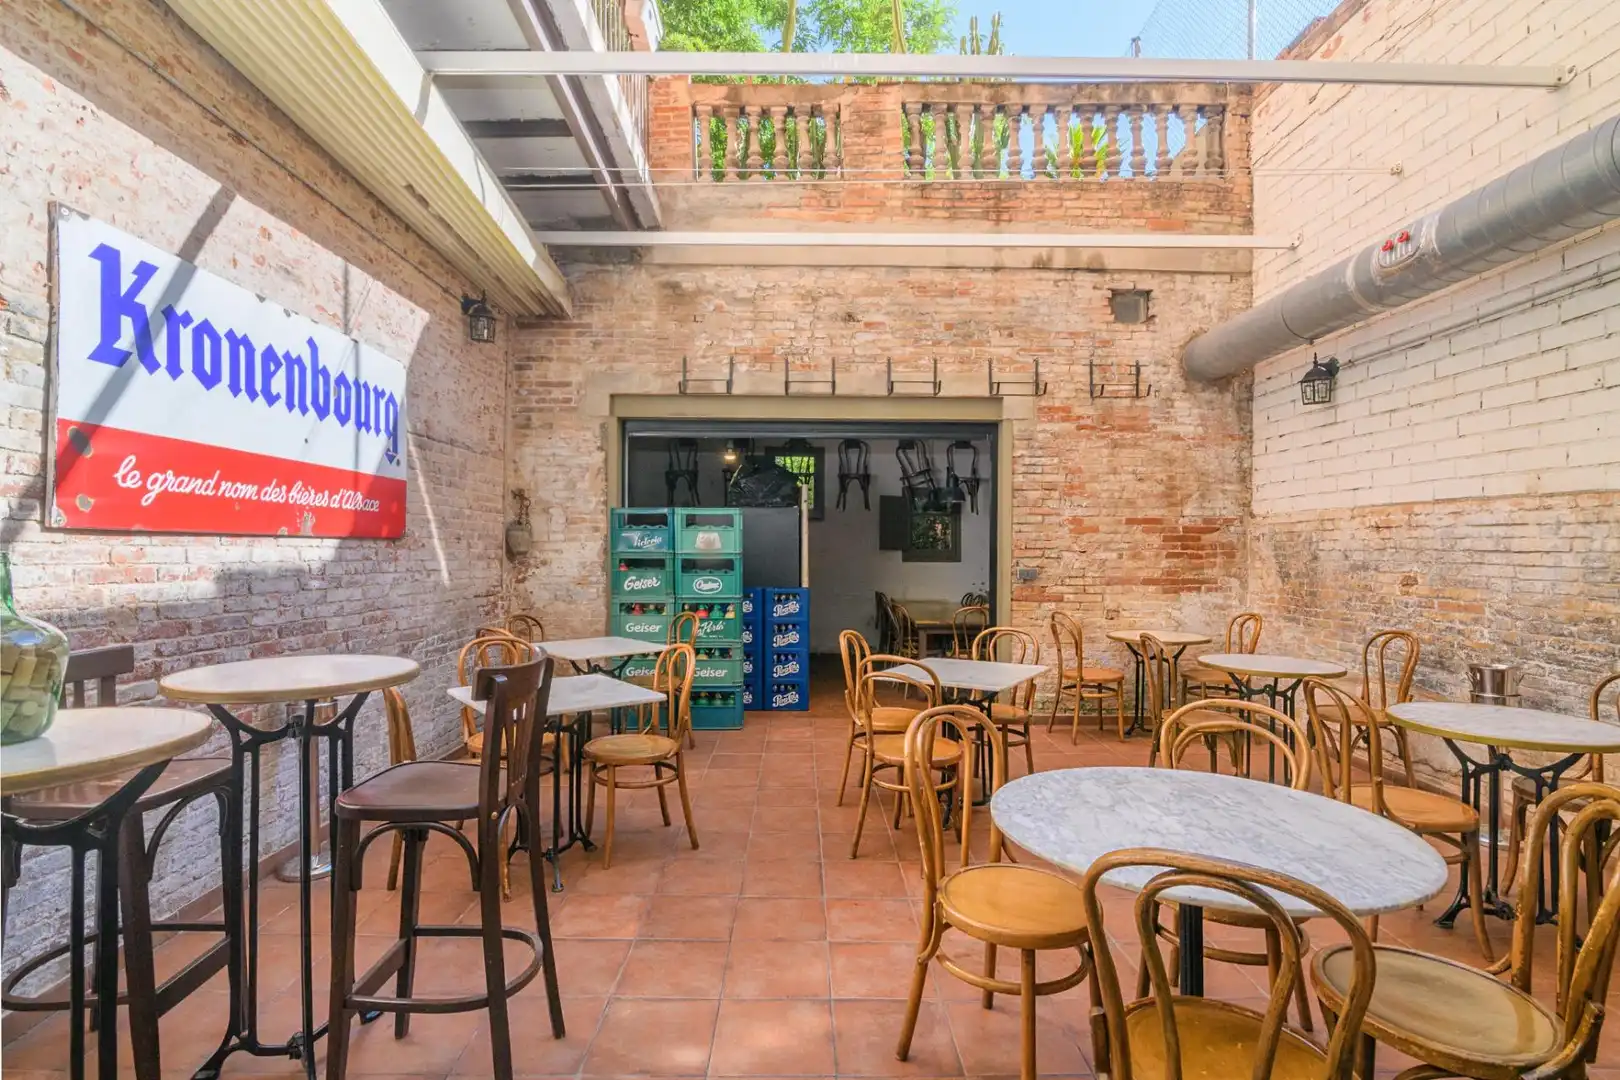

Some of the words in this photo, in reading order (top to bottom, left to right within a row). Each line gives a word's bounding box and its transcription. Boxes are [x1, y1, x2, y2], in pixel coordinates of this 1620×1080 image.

[87, 242, 401, 465] Kronenbourg
[113, 455, 142, 489] le
[141, 470, 218, 506] grand
[221, 480, 258, 499] nom
[260, 478, 288, 503] des
[288, 480, 329, 507] bières
[330, 487, 380, 512] d'Alsace
[621, 531, 662, 549] Victoria
[623, 575, 661, 591] Geiser
[625, 622, 662, 633] Geiser
[625, 666, 657, 677] Geise
[694, 667, 728, 678] Geiser
